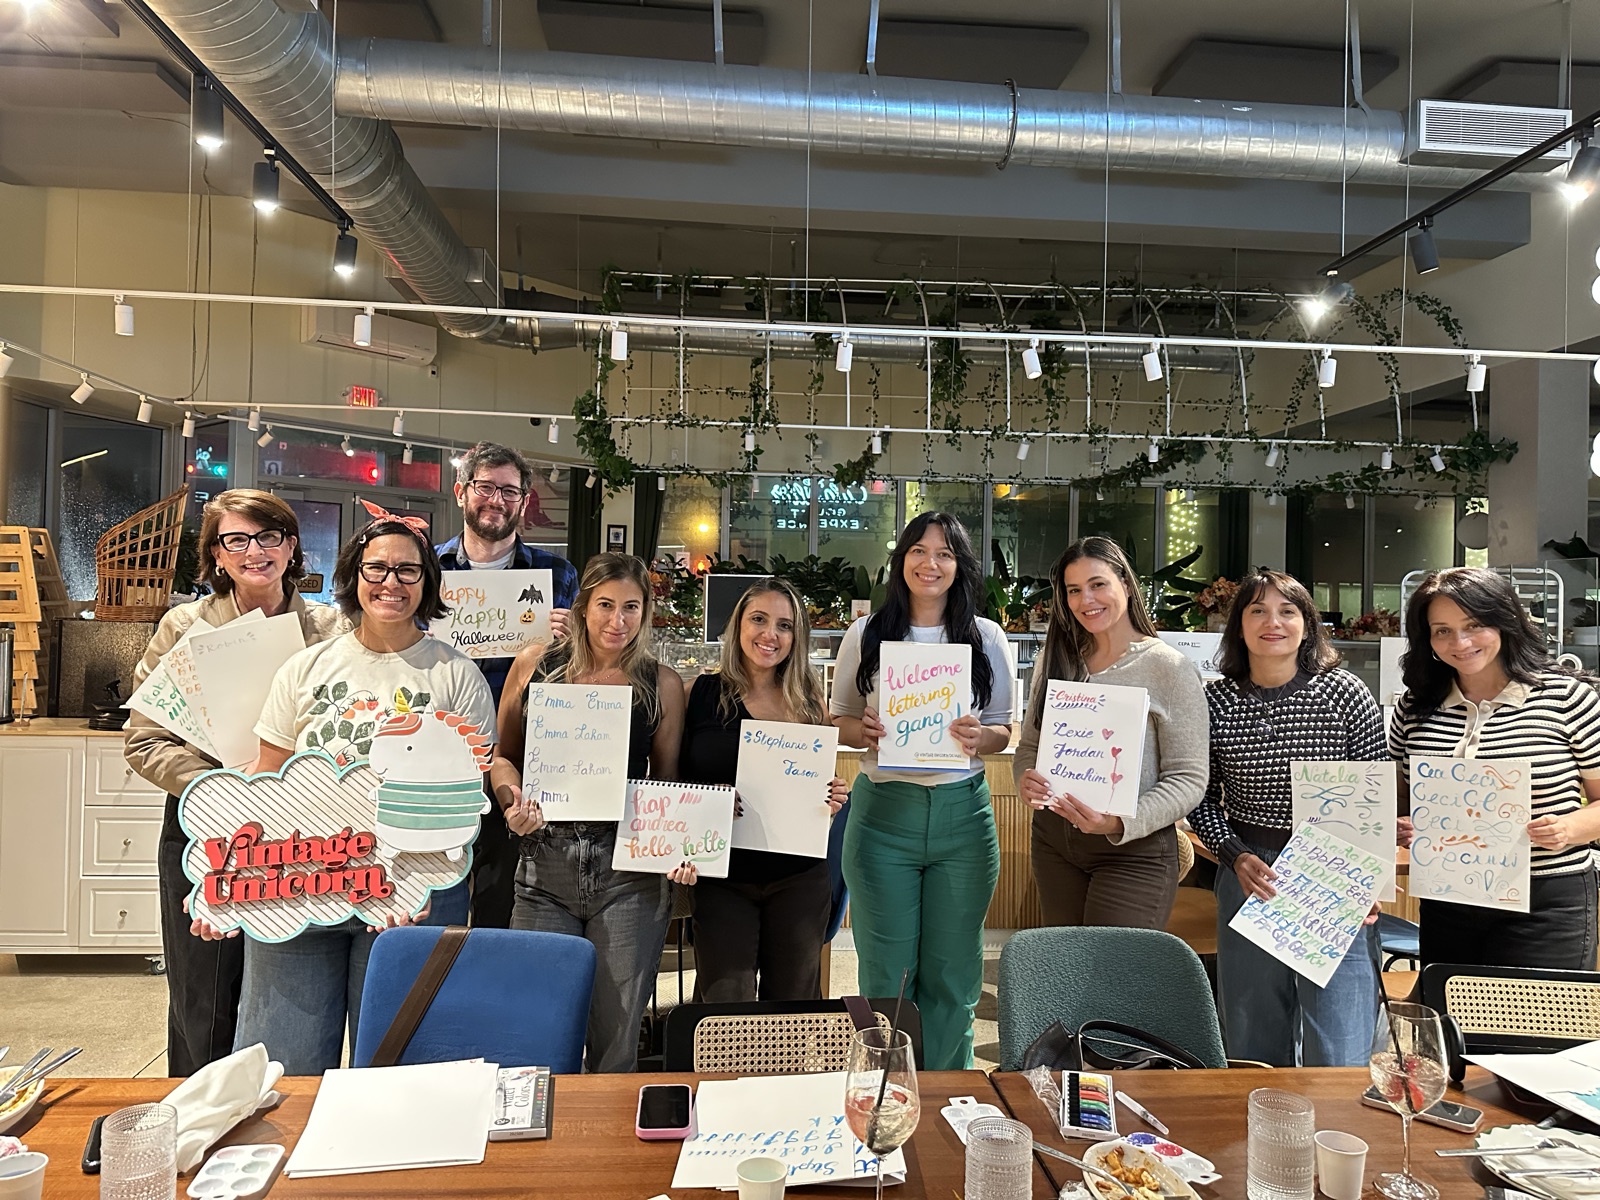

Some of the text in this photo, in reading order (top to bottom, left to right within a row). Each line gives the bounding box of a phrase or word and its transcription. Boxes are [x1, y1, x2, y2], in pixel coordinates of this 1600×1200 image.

[352, 386, 376, 407] EXIT
[447, 606, 507, 630] Happy
[884, 663, 963, 691] Welcome
[532, 687, 625, 710] Emma Emma
[886, 682, 956, 717] lettering
[1055, 690, 1097, 704] Cristina
[531, 715, 568, 740] Emma
[1053, 722, 1094, 739] Lexie
[753, 730, 808, 751] Stephanie
[1053, 743, 1104, 759] Jordan
[528, 746, 566, 774] Emma
[1050, 763, 1108, 784] Ibrahim
[1293, 764, 1360, 785] Natalia
[629, 816, 688, 834] andrea
[1411, 806, 1462, 832] Ceci
[204, 821, 374, 870] Vintage
[624, 829, 727, 859] hello hello
[204, 864, 394, 905] Unicorn
[514, 1085, 530, 1107] Colors
